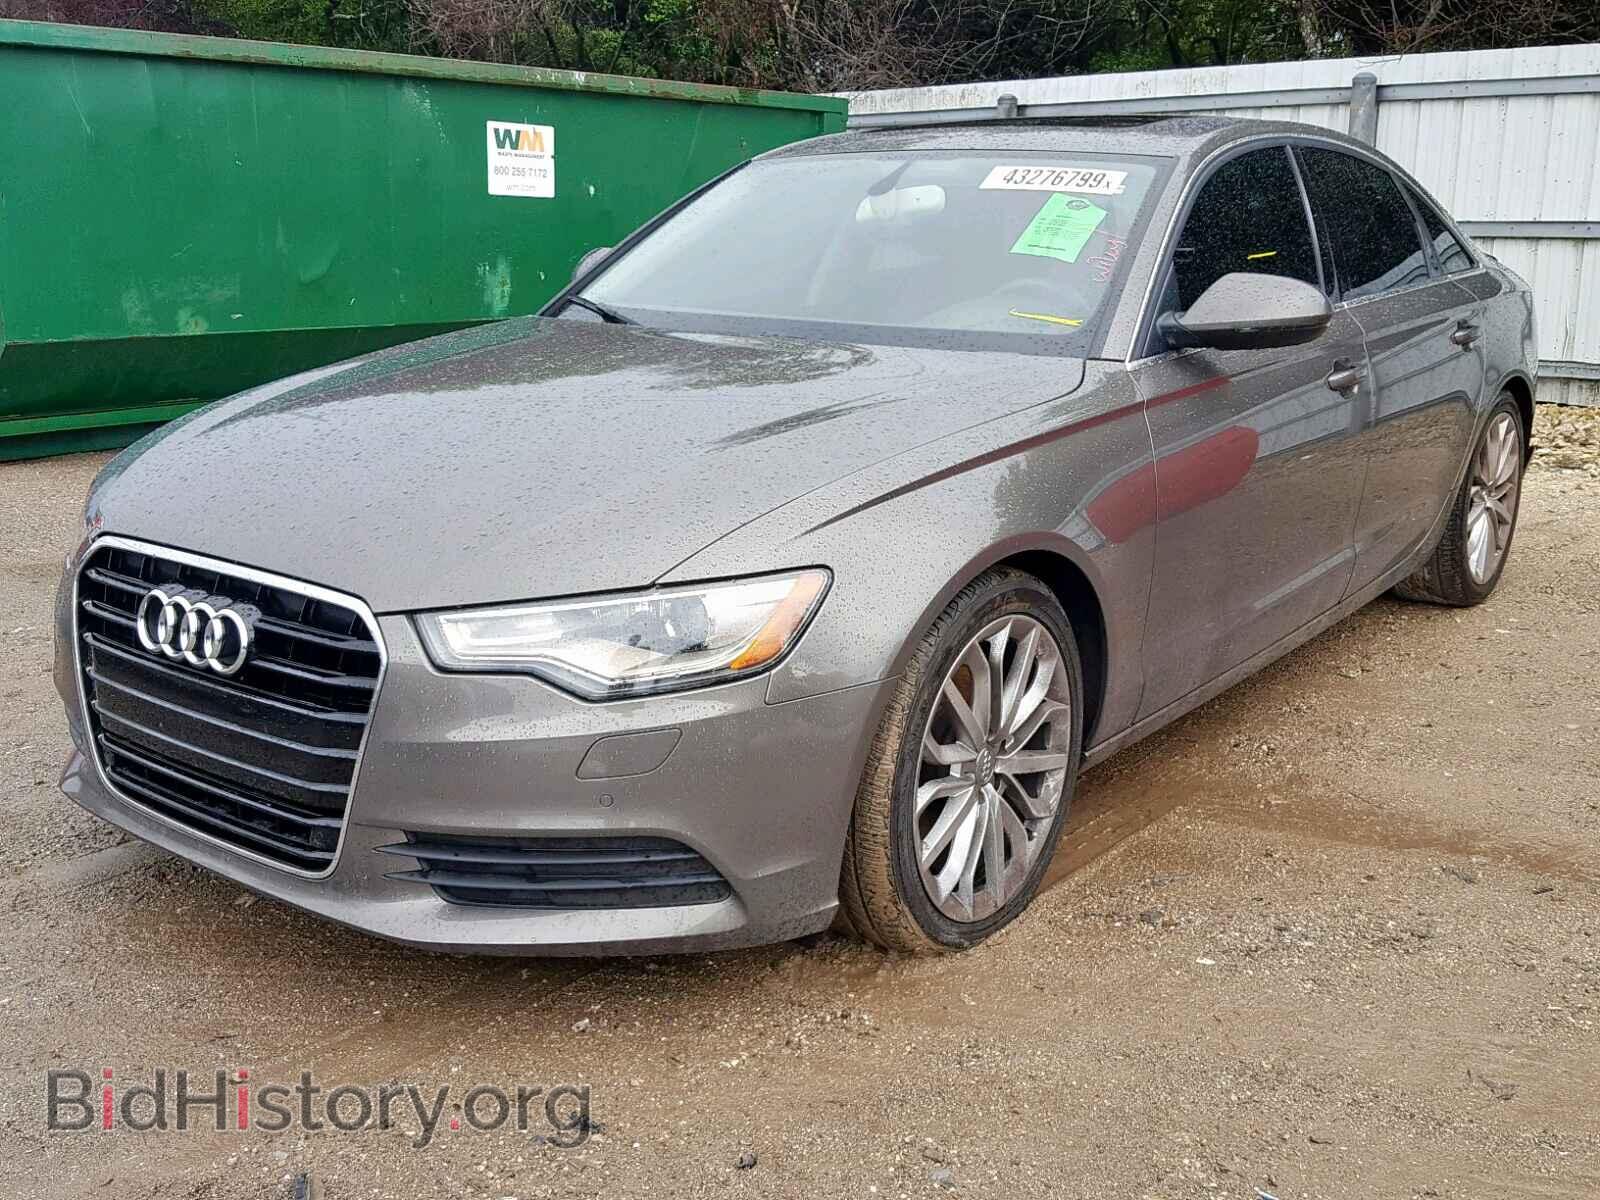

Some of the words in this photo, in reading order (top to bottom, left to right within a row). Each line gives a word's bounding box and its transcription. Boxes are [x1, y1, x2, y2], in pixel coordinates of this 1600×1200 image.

[493, 127, 545, 152] WM
[494, 165, 509, 176] 800
[511, 166, 526, 177] 255
[527, 167, 548, 178] 7172
